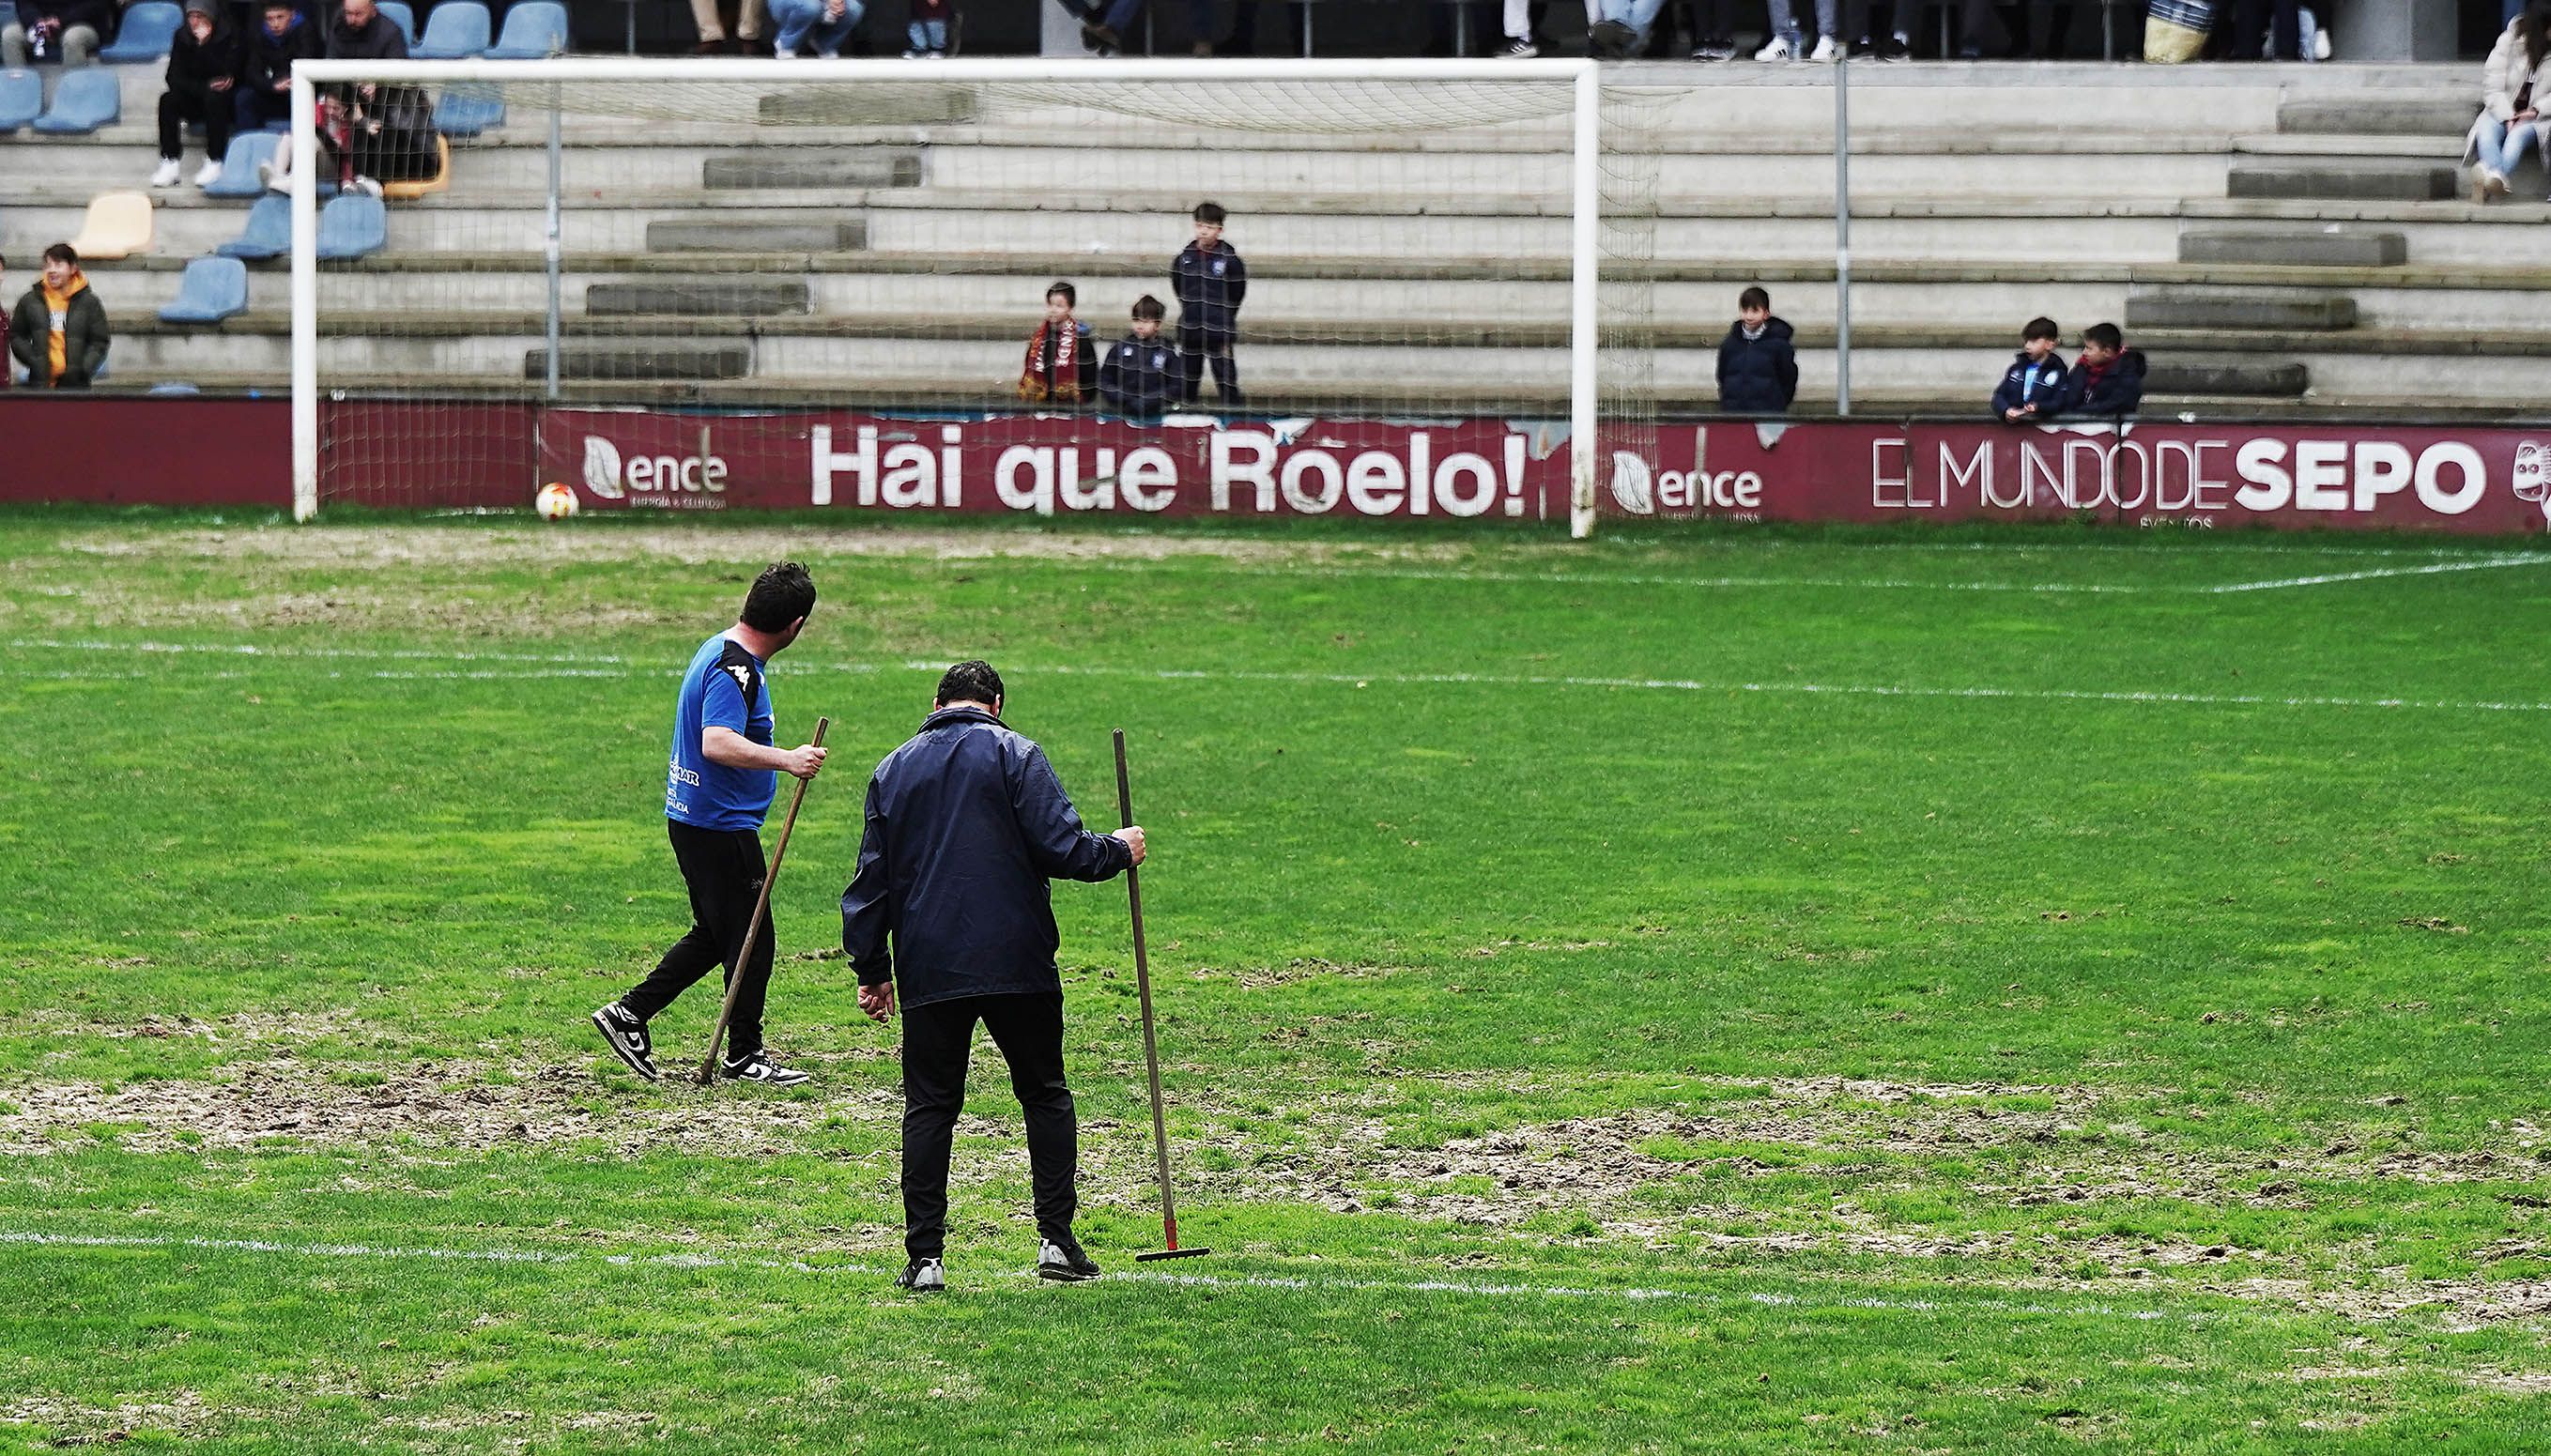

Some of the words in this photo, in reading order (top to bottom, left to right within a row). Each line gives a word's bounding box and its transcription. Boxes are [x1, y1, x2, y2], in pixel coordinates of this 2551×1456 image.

[626, 455, 728, 492] ence
[810, 424, 963, 508] Hai
[994, 444, 1178, 517] que
[1210, 430, 1526, 517] Roelo!
[1657, 469, 1762, 508] ence
[1873, 438, 1933, 508] EL
[1940, 439, 2148, 510] MUNDO
[2157, 440, 2229, 510] DE
[2235, 437, 2487, 514] SEPO
